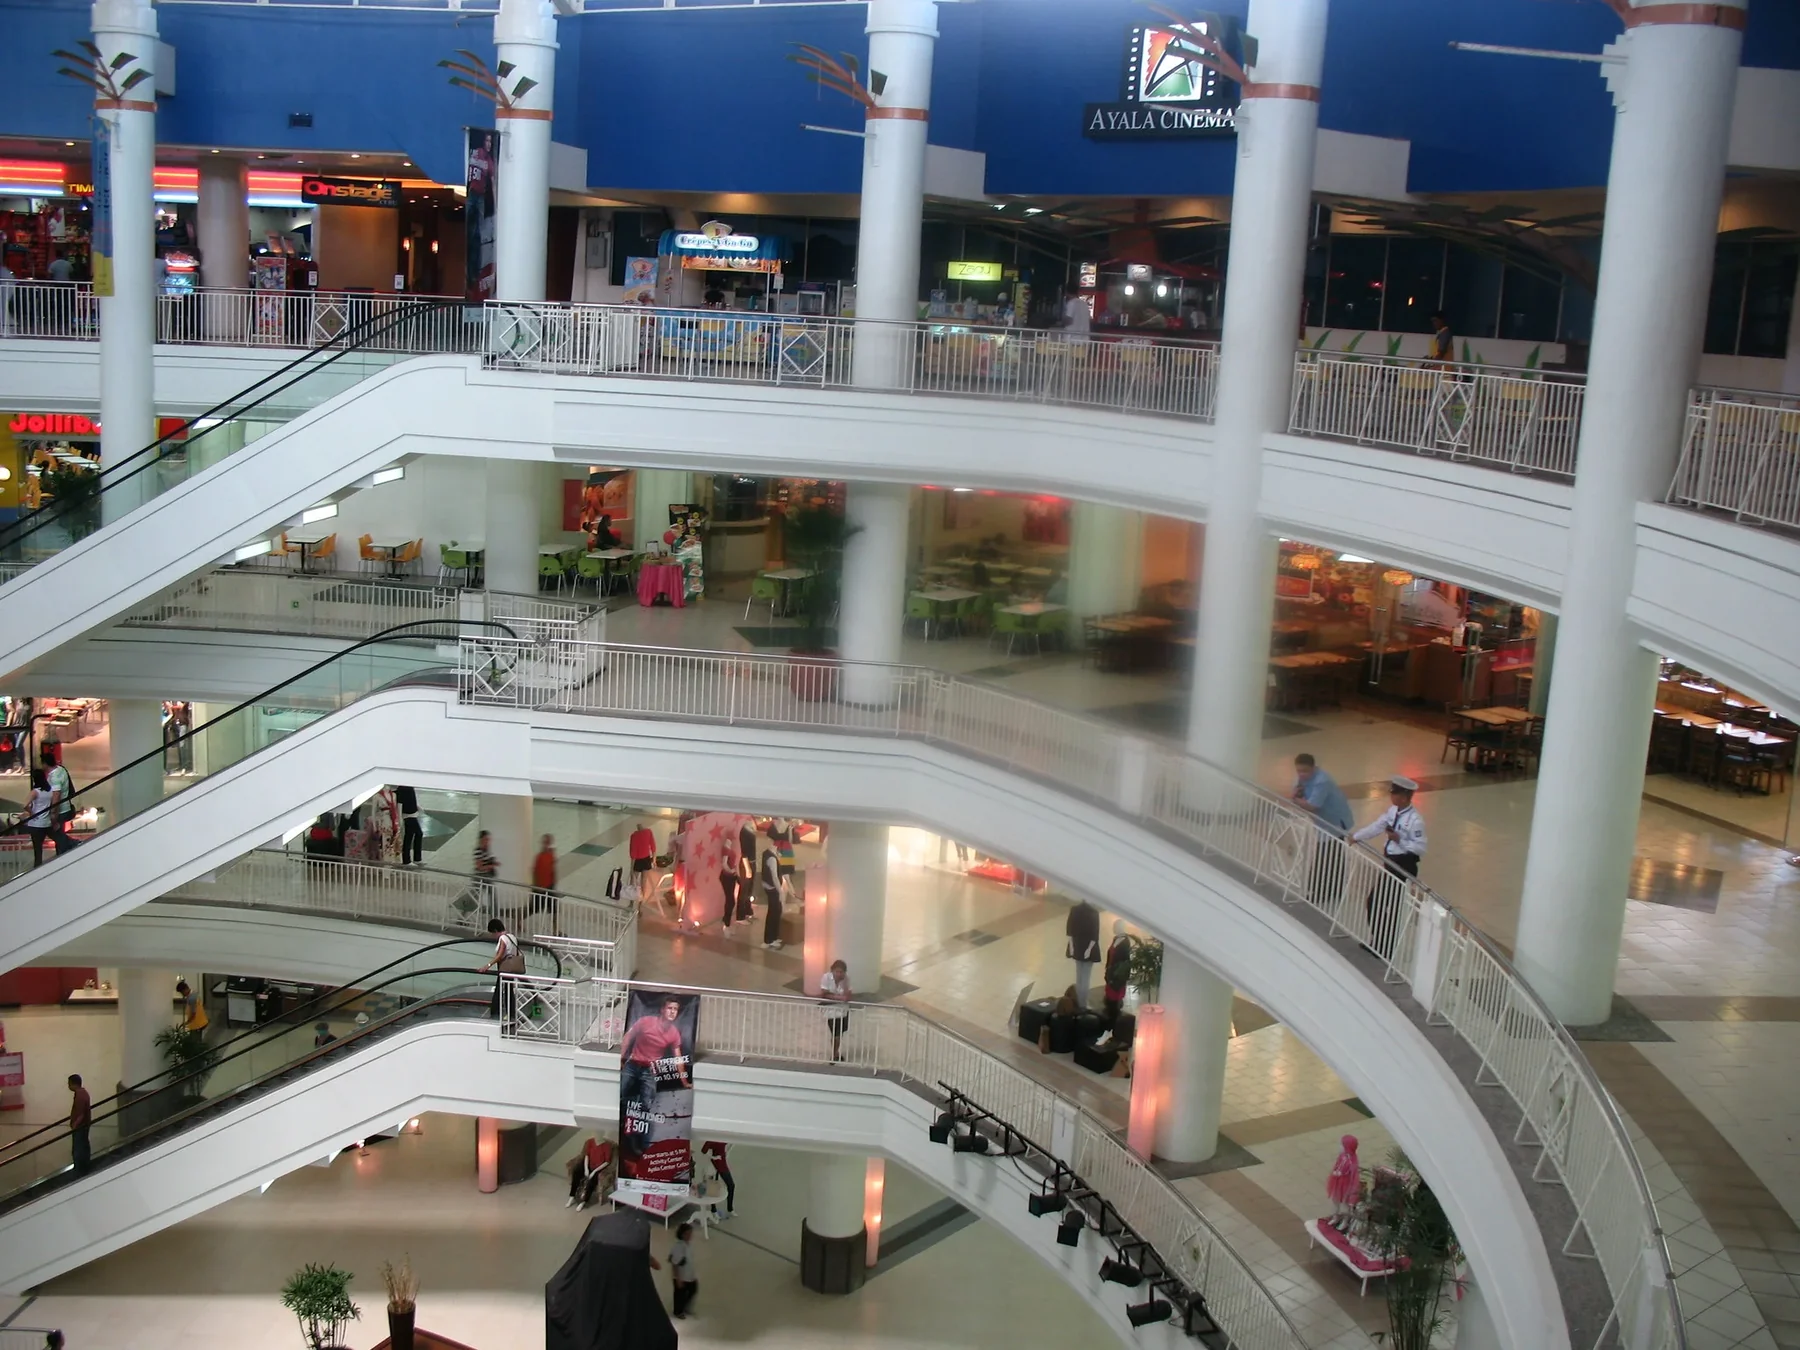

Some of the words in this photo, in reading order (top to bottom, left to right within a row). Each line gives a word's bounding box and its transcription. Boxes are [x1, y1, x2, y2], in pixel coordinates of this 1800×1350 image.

[1089, 108, 1156, 130] AYALA
[1160, 104, 1241, 129] CINEMA
[304, 181, 393, 201] Onstage
[627, 1100, 643, 1111] LIVE
[632, 1119, 650, 1134] 501
